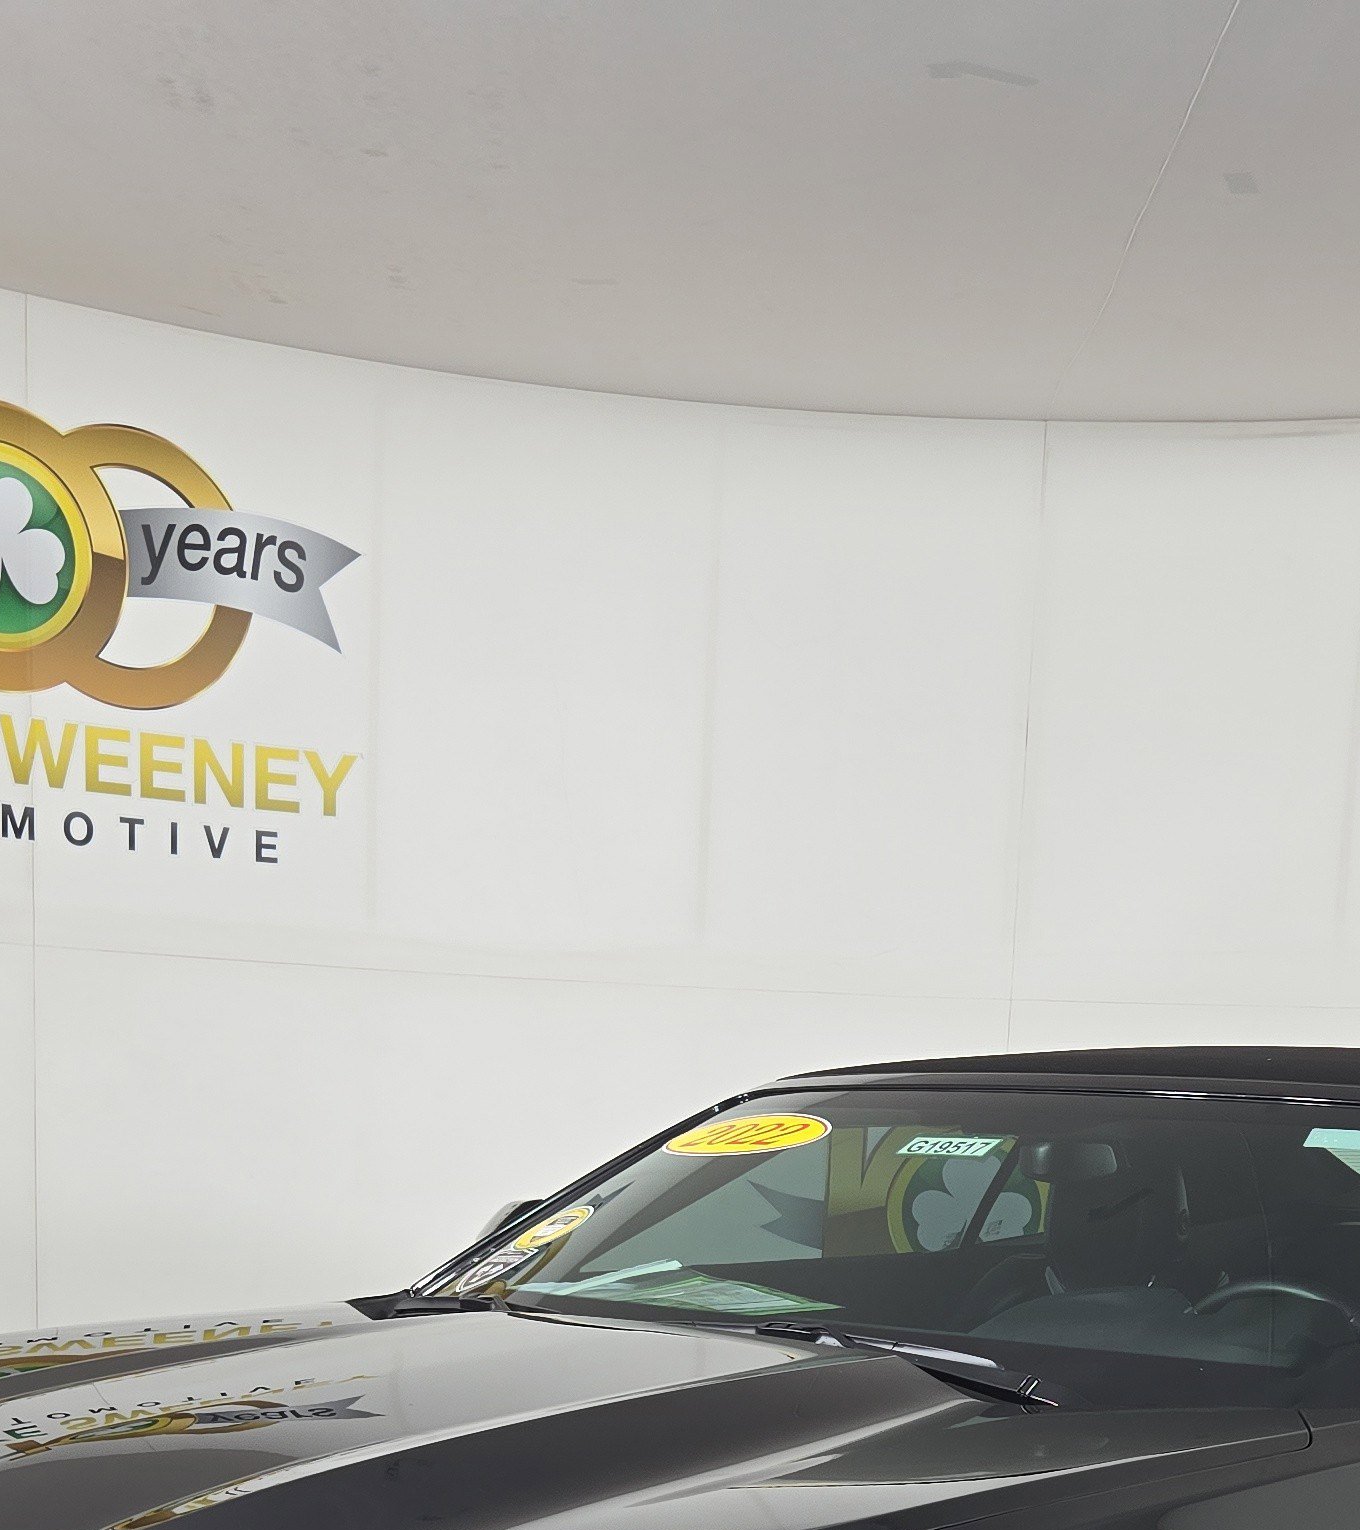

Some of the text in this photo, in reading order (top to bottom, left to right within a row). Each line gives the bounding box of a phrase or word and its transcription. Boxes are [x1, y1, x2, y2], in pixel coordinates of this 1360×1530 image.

[140, 520, 306, 593] years
[685, 1122, 811, 1148] 2022
[906, 1140, 993, 1155] G19517
